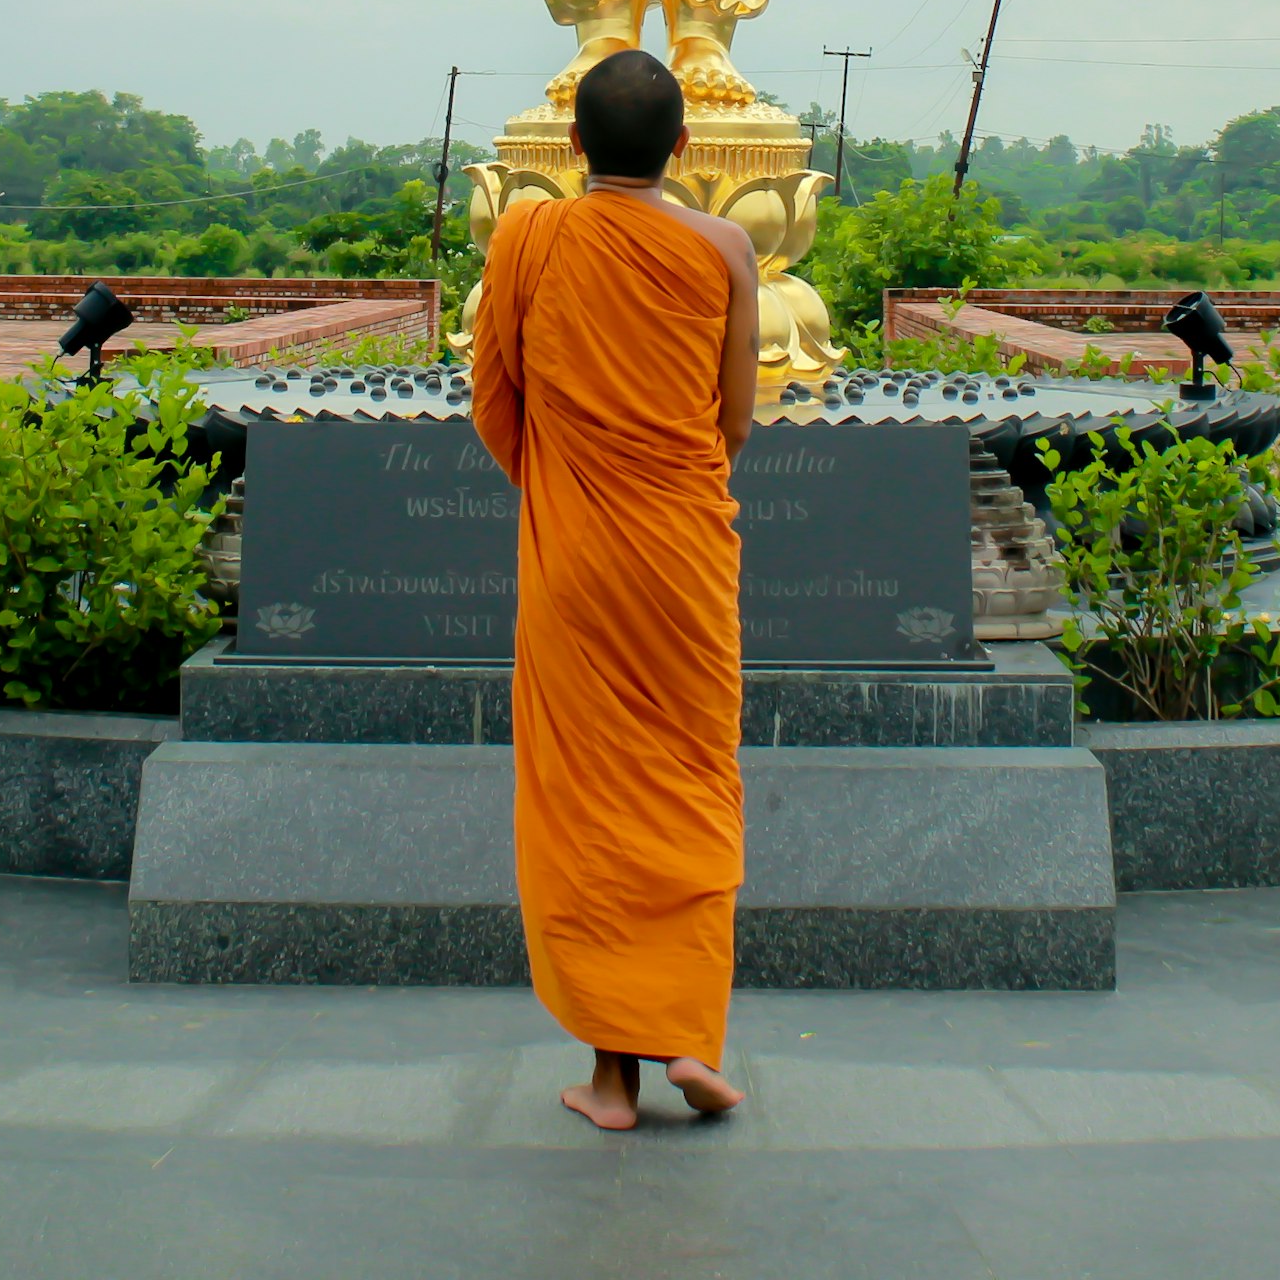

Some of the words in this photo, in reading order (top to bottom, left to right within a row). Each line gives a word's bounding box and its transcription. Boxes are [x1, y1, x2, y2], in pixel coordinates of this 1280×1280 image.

[376, 443, 433, 472] The
[456, 442, 498, 472] Bo
[736, 498, 809, 530] กุมาร
[312, 568, 517, 595] สร้างด้วยพลังศรัท
[422, 613, 499, 637] VISIT
